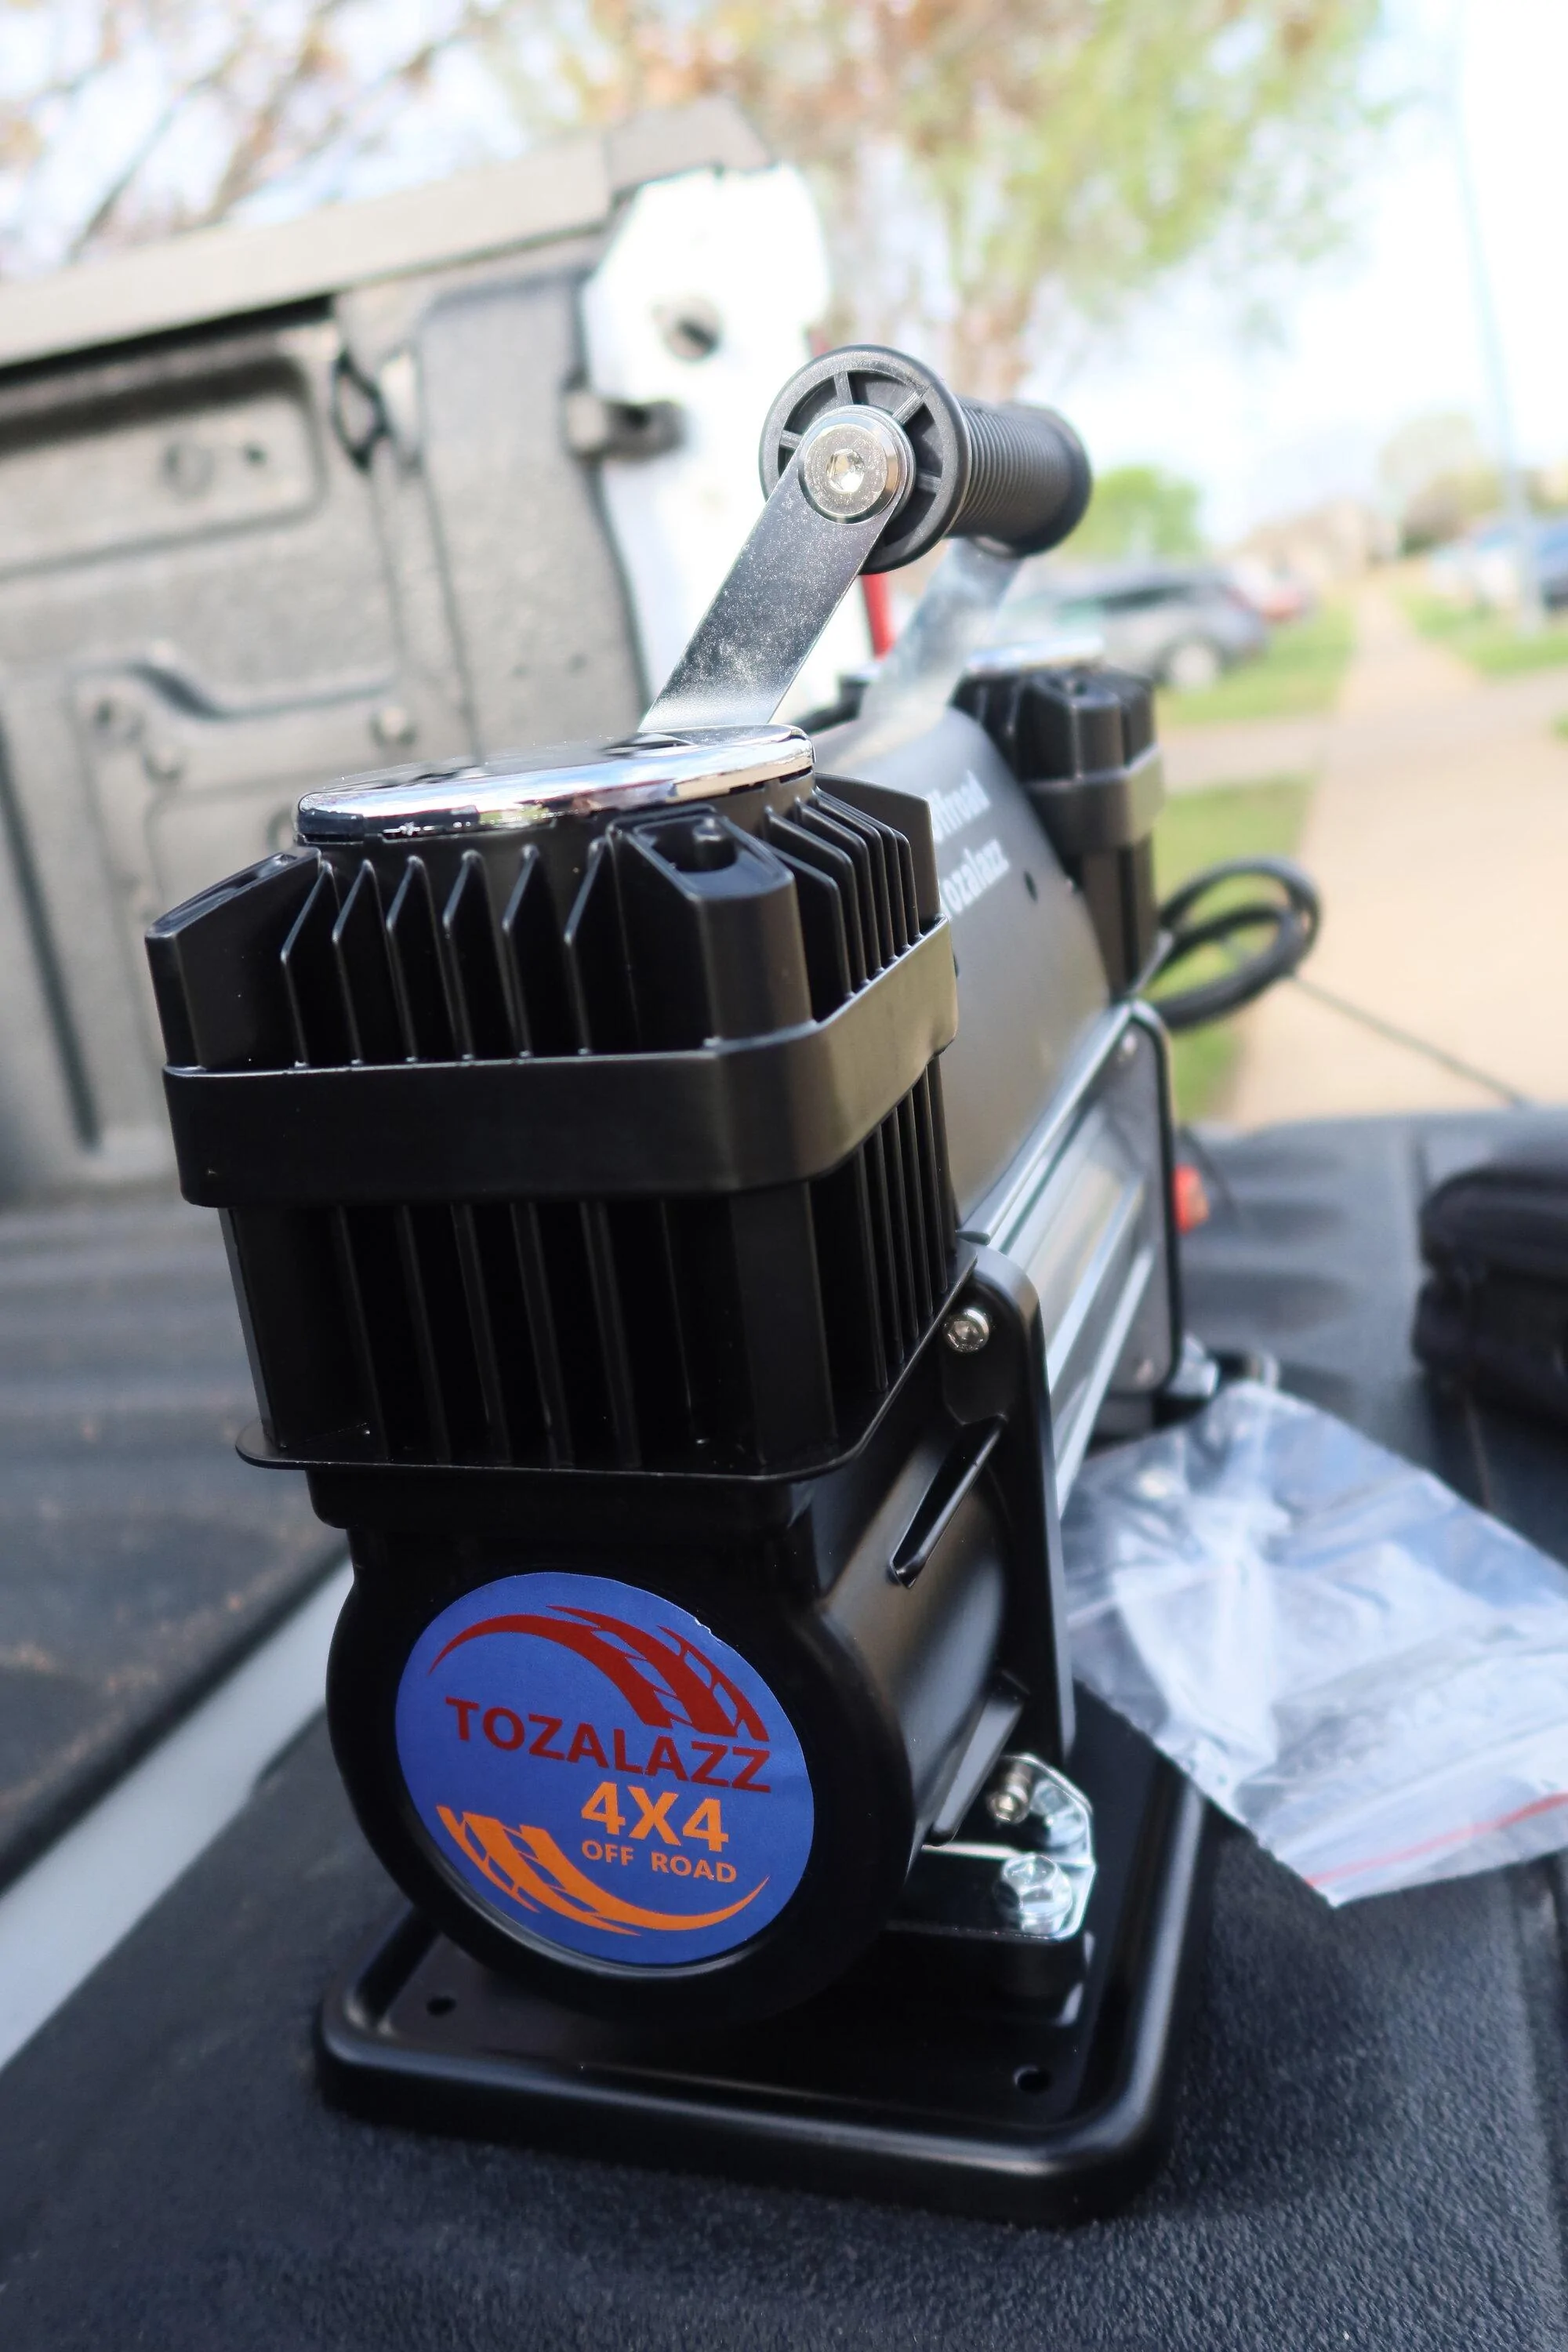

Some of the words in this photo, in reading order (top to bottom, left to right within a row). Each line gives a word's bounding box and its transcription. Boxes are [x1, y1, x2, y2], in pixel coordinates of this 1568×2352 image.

[445, 1697, 771, 1794] TOZALAZZ
[580, 1781, 730, 1853] 4X4
[581, 1838, 633, 1866] OFF
[651, 1852, 738, 1883] ROAD
